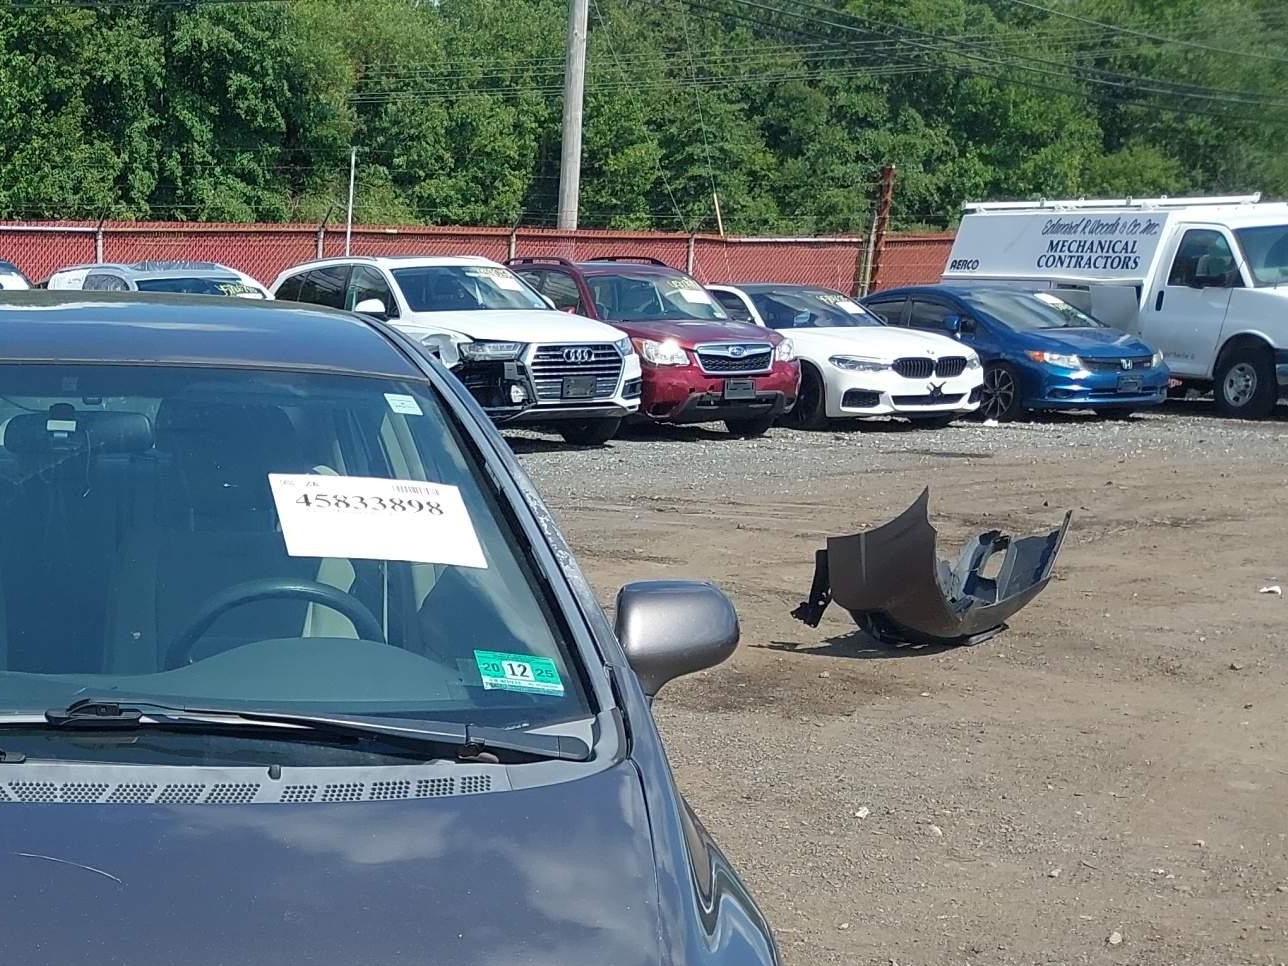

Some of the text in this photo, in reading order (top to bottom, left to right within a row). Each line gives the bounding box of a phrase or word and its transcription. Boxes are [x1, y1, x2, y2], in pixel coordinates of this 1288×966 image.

[1046, 239, 1138, 254] MECHANICAL
[950, 259, 980, 270] AERCO
[1036, 254, 1141, 270] CONTRACTORS
[295, 493, 445, 516] 45833898
[507, 663, 530, 678] 12
